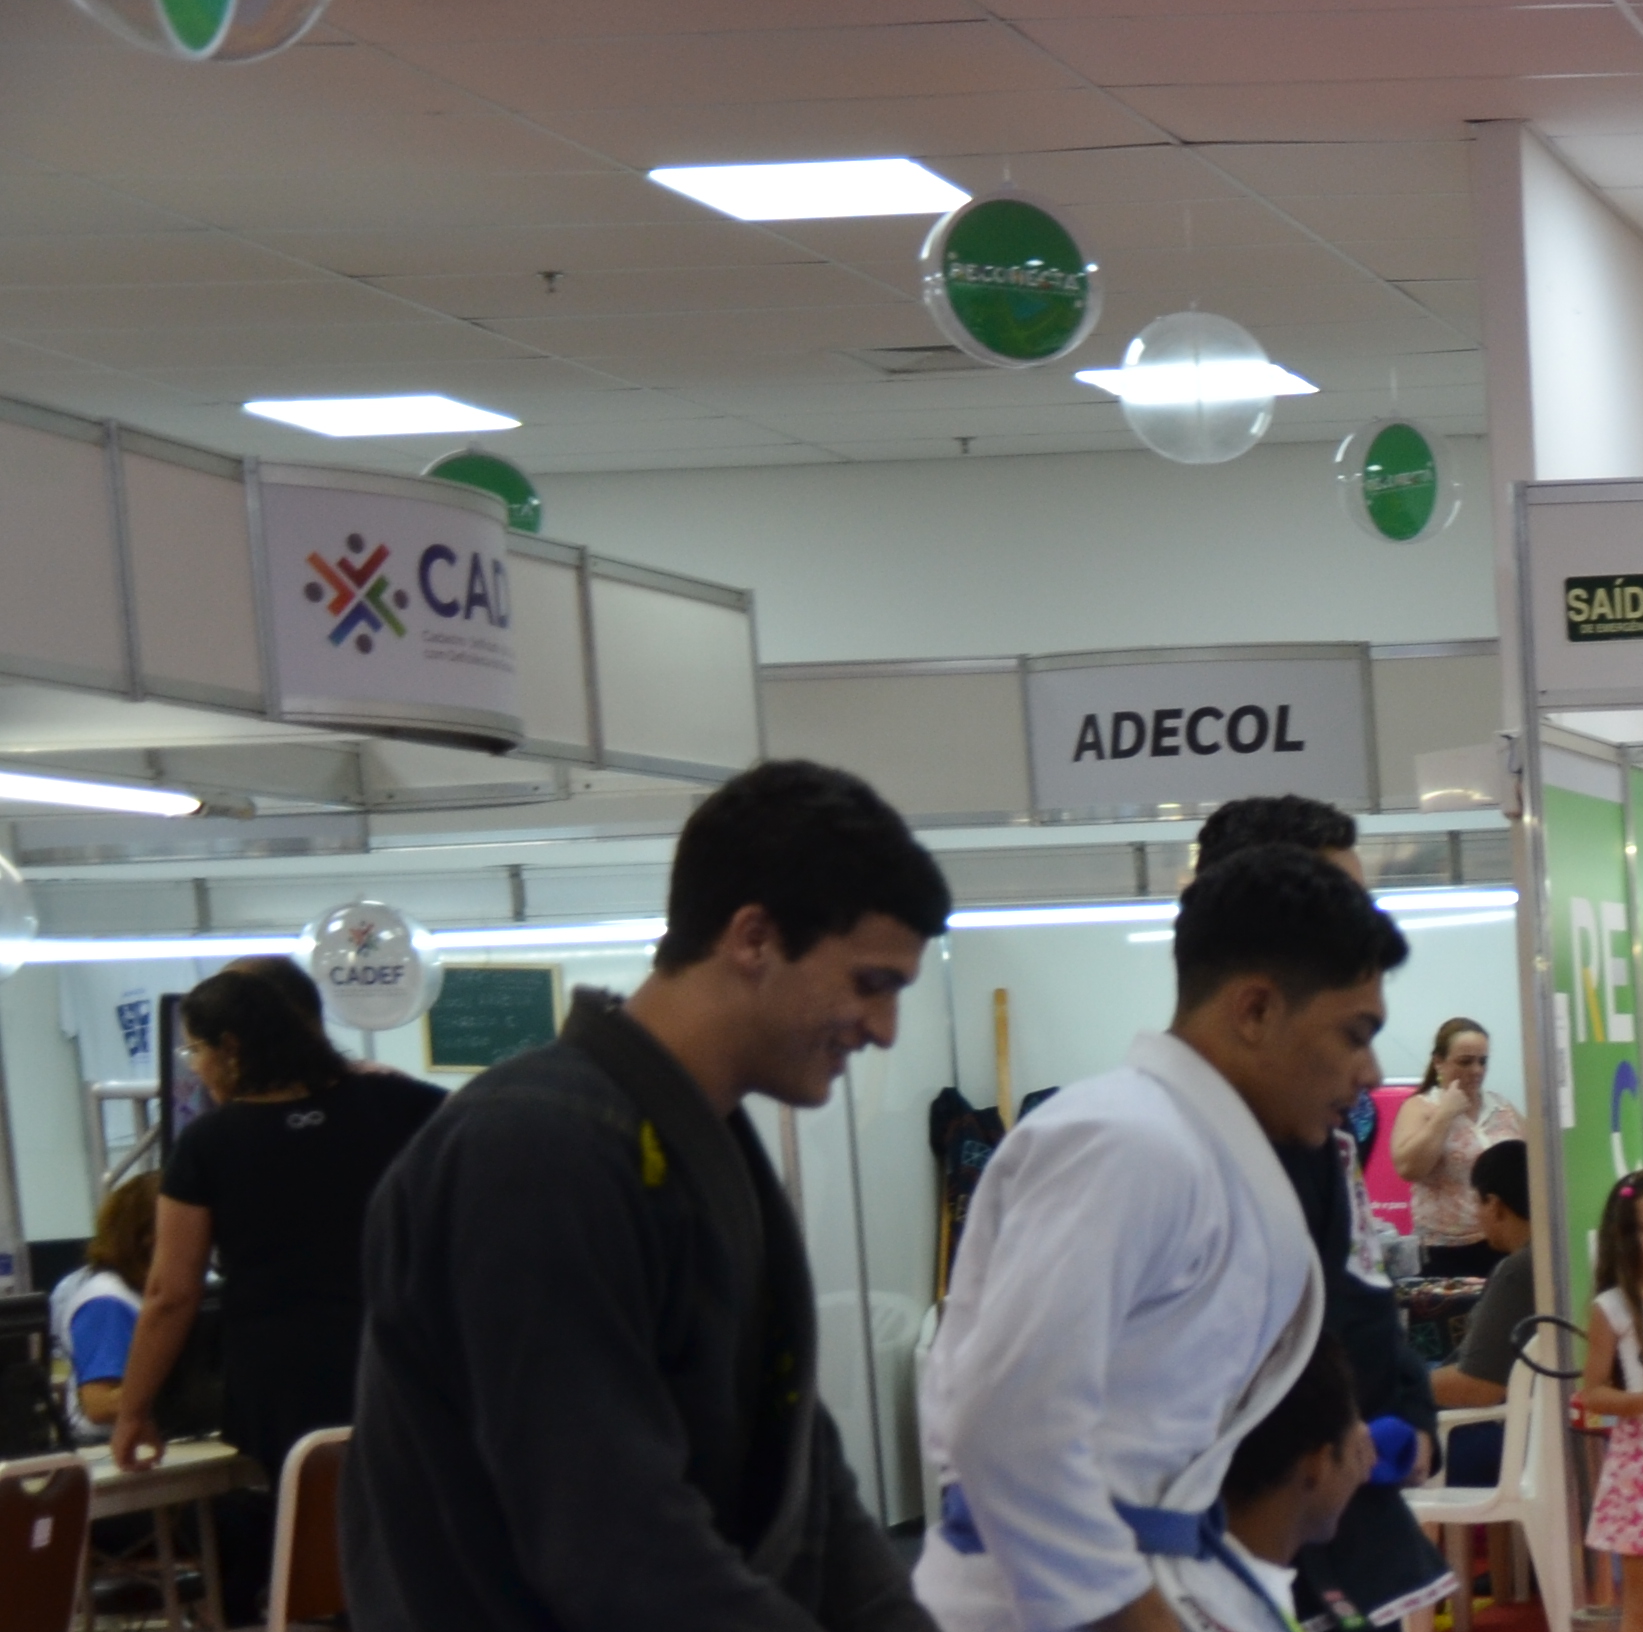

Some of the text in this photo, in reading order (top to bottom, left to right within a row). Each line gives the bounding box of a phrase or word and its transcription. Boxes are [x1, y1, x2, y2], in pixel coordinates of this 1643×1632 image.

[1072, 703, 1305, 762] ADECOL
[329, 964, 405, 986] CADEF
[1570, 897, 1636, 1044] RE
